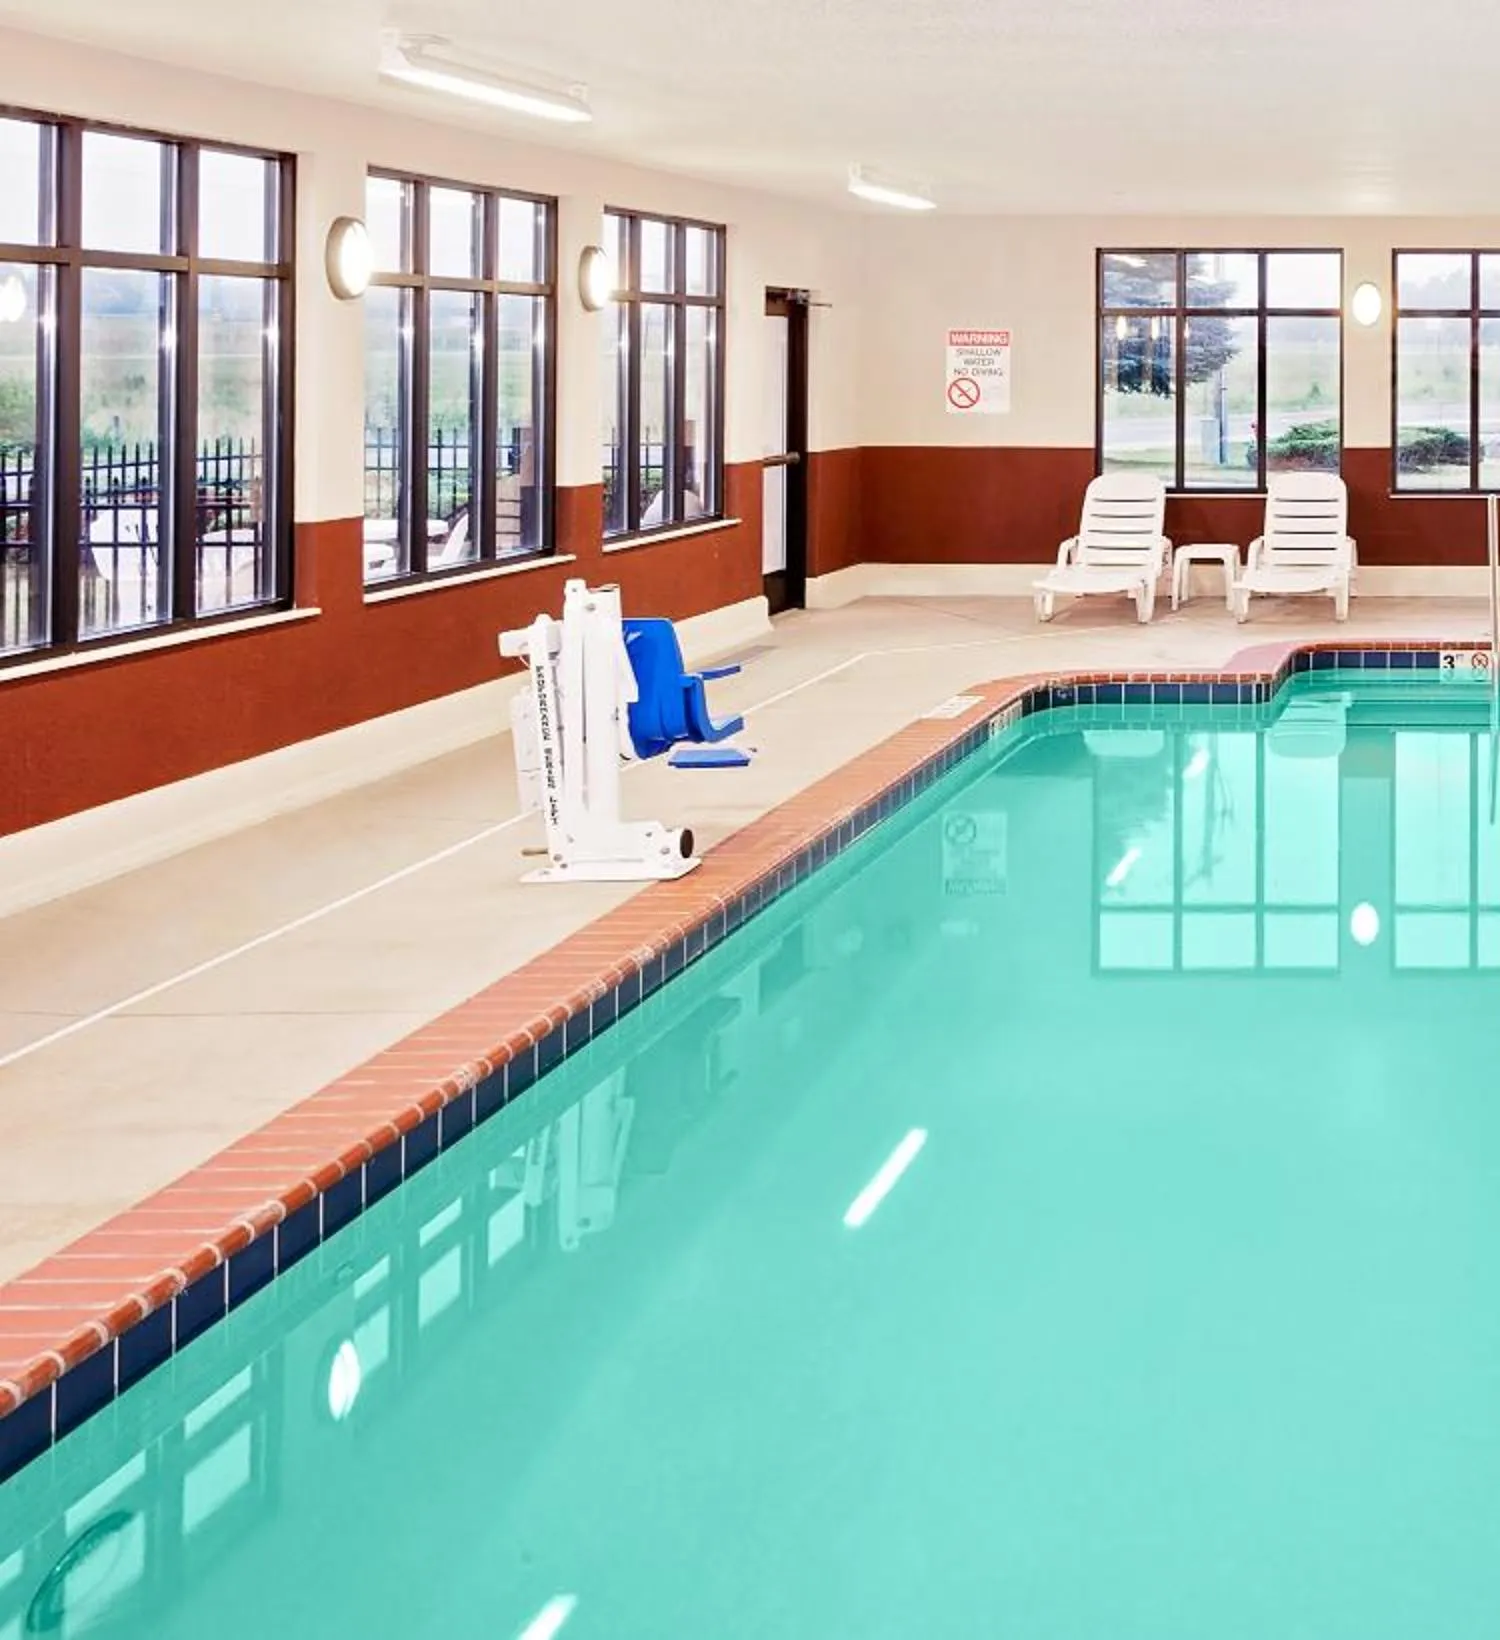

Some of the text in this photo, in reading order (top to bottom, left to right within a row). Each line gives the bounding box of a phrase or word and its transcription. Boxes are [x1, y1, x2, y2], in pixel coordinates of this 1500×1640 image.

[951, 332, 1007, 345] WARNING
[956, 348, 1002, 356] SHALLOW
[963, 358, 995, 366] WATER
[953, 368, 1003, 376] NO DIVING
[1443, 655, 1455, 669] 3
